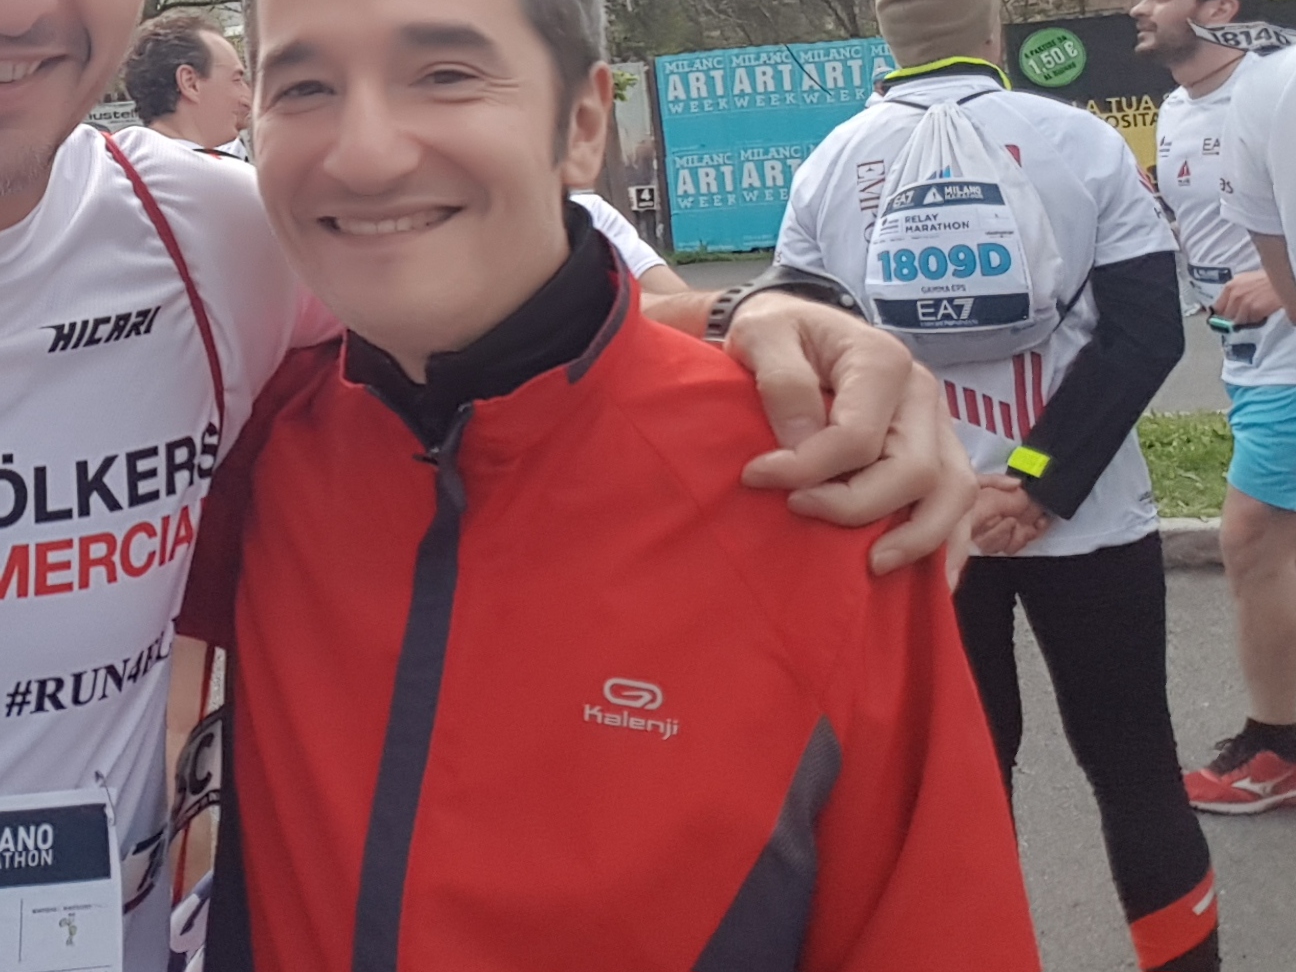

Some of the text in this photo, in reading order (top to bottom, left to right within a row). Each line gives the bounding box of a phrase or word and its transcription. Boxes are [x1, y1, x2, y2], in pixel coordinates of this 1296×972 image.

[733, 64, 792, 95] ART
[802, 59, 863, 90] ART
[667, 69, 724, 101] ART
[734, 92, 796, 108] WEEK
[803, 88, 865, 103] WEEK
[1106, 94, 1156, 113] TUA
[668, 98, 728, 114] WEEK
[677, 165, 734, 196] ART
[640, 188, 651, 201] 4
[944, 186, 982, 195] MILANO
[905, 213, 939, 224] RELAY
[905, 221, 969, 234] MARATHON
[877, 242, 1012, 283] 1809D
[916, 298, 975, 321] EA7
[583, 704, 679, 741] Kalenji
